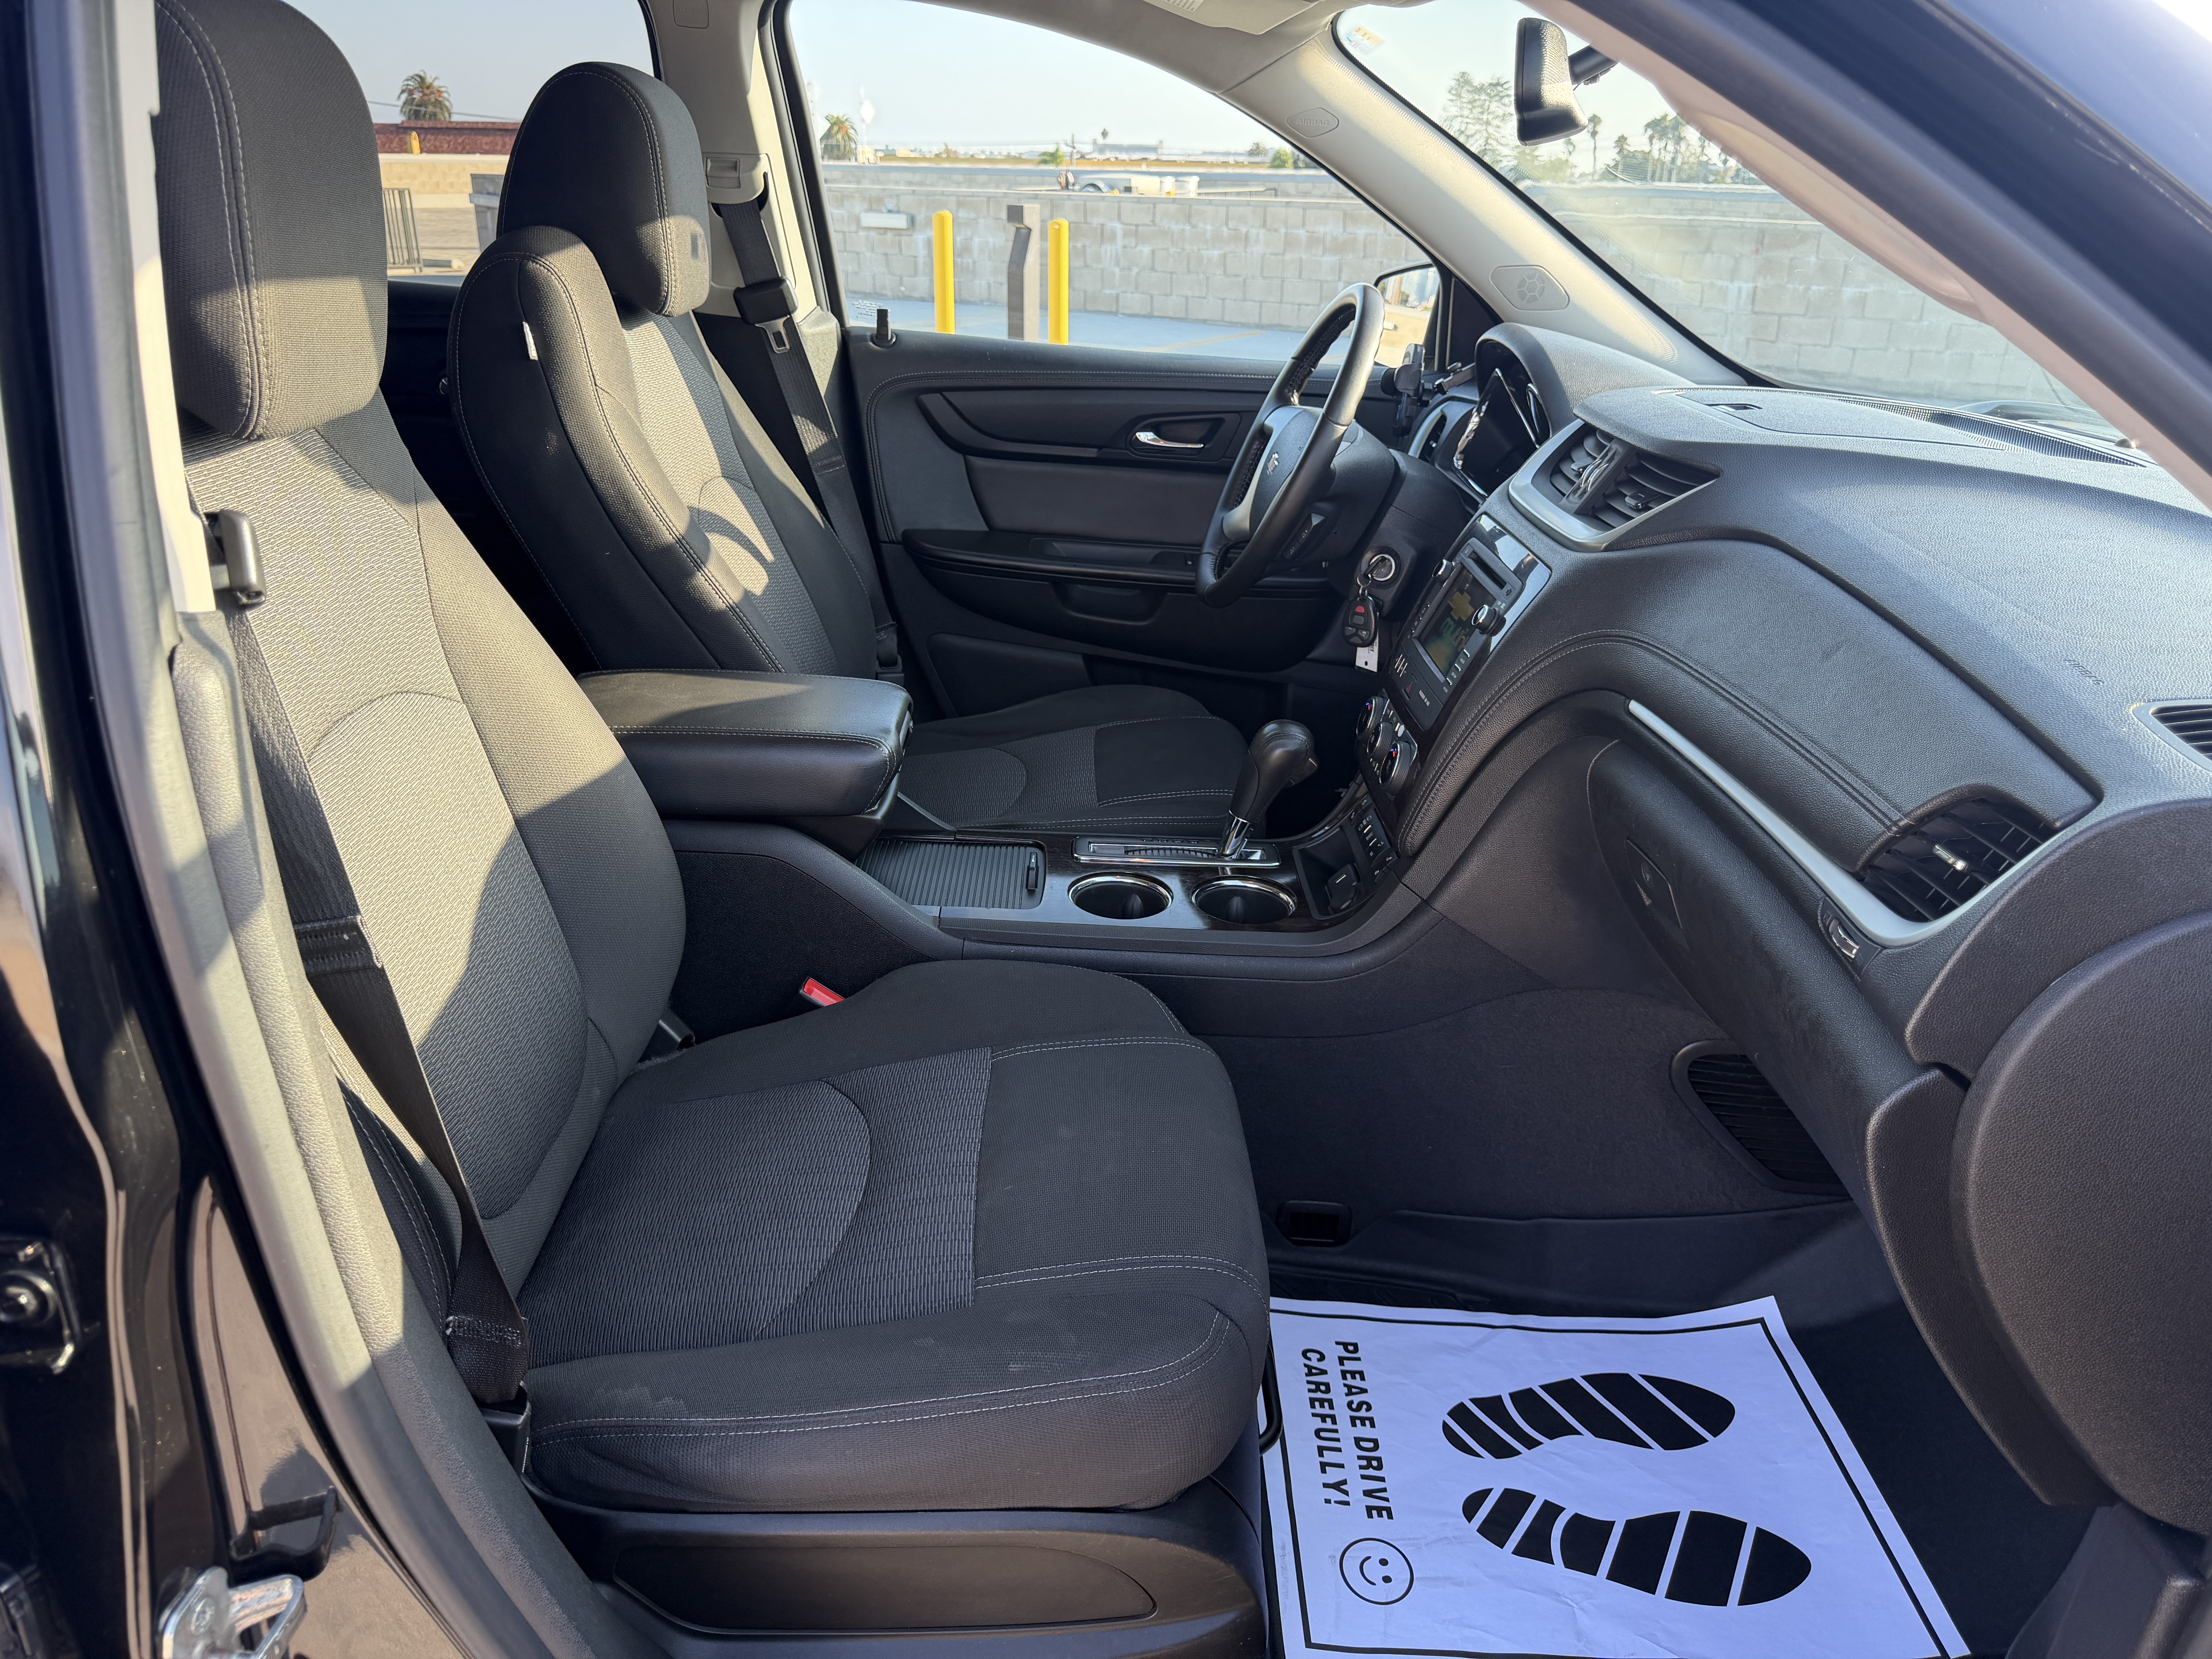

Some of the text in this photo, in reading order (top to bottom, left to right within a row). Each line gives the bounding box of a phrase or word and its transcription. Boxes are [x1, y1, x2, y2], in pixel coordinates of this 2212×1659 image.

[1302, 1348, 1350, 1506] CAREFULLY!
[1335, 1341, 1394, 1520] PLEASE DRIVE
